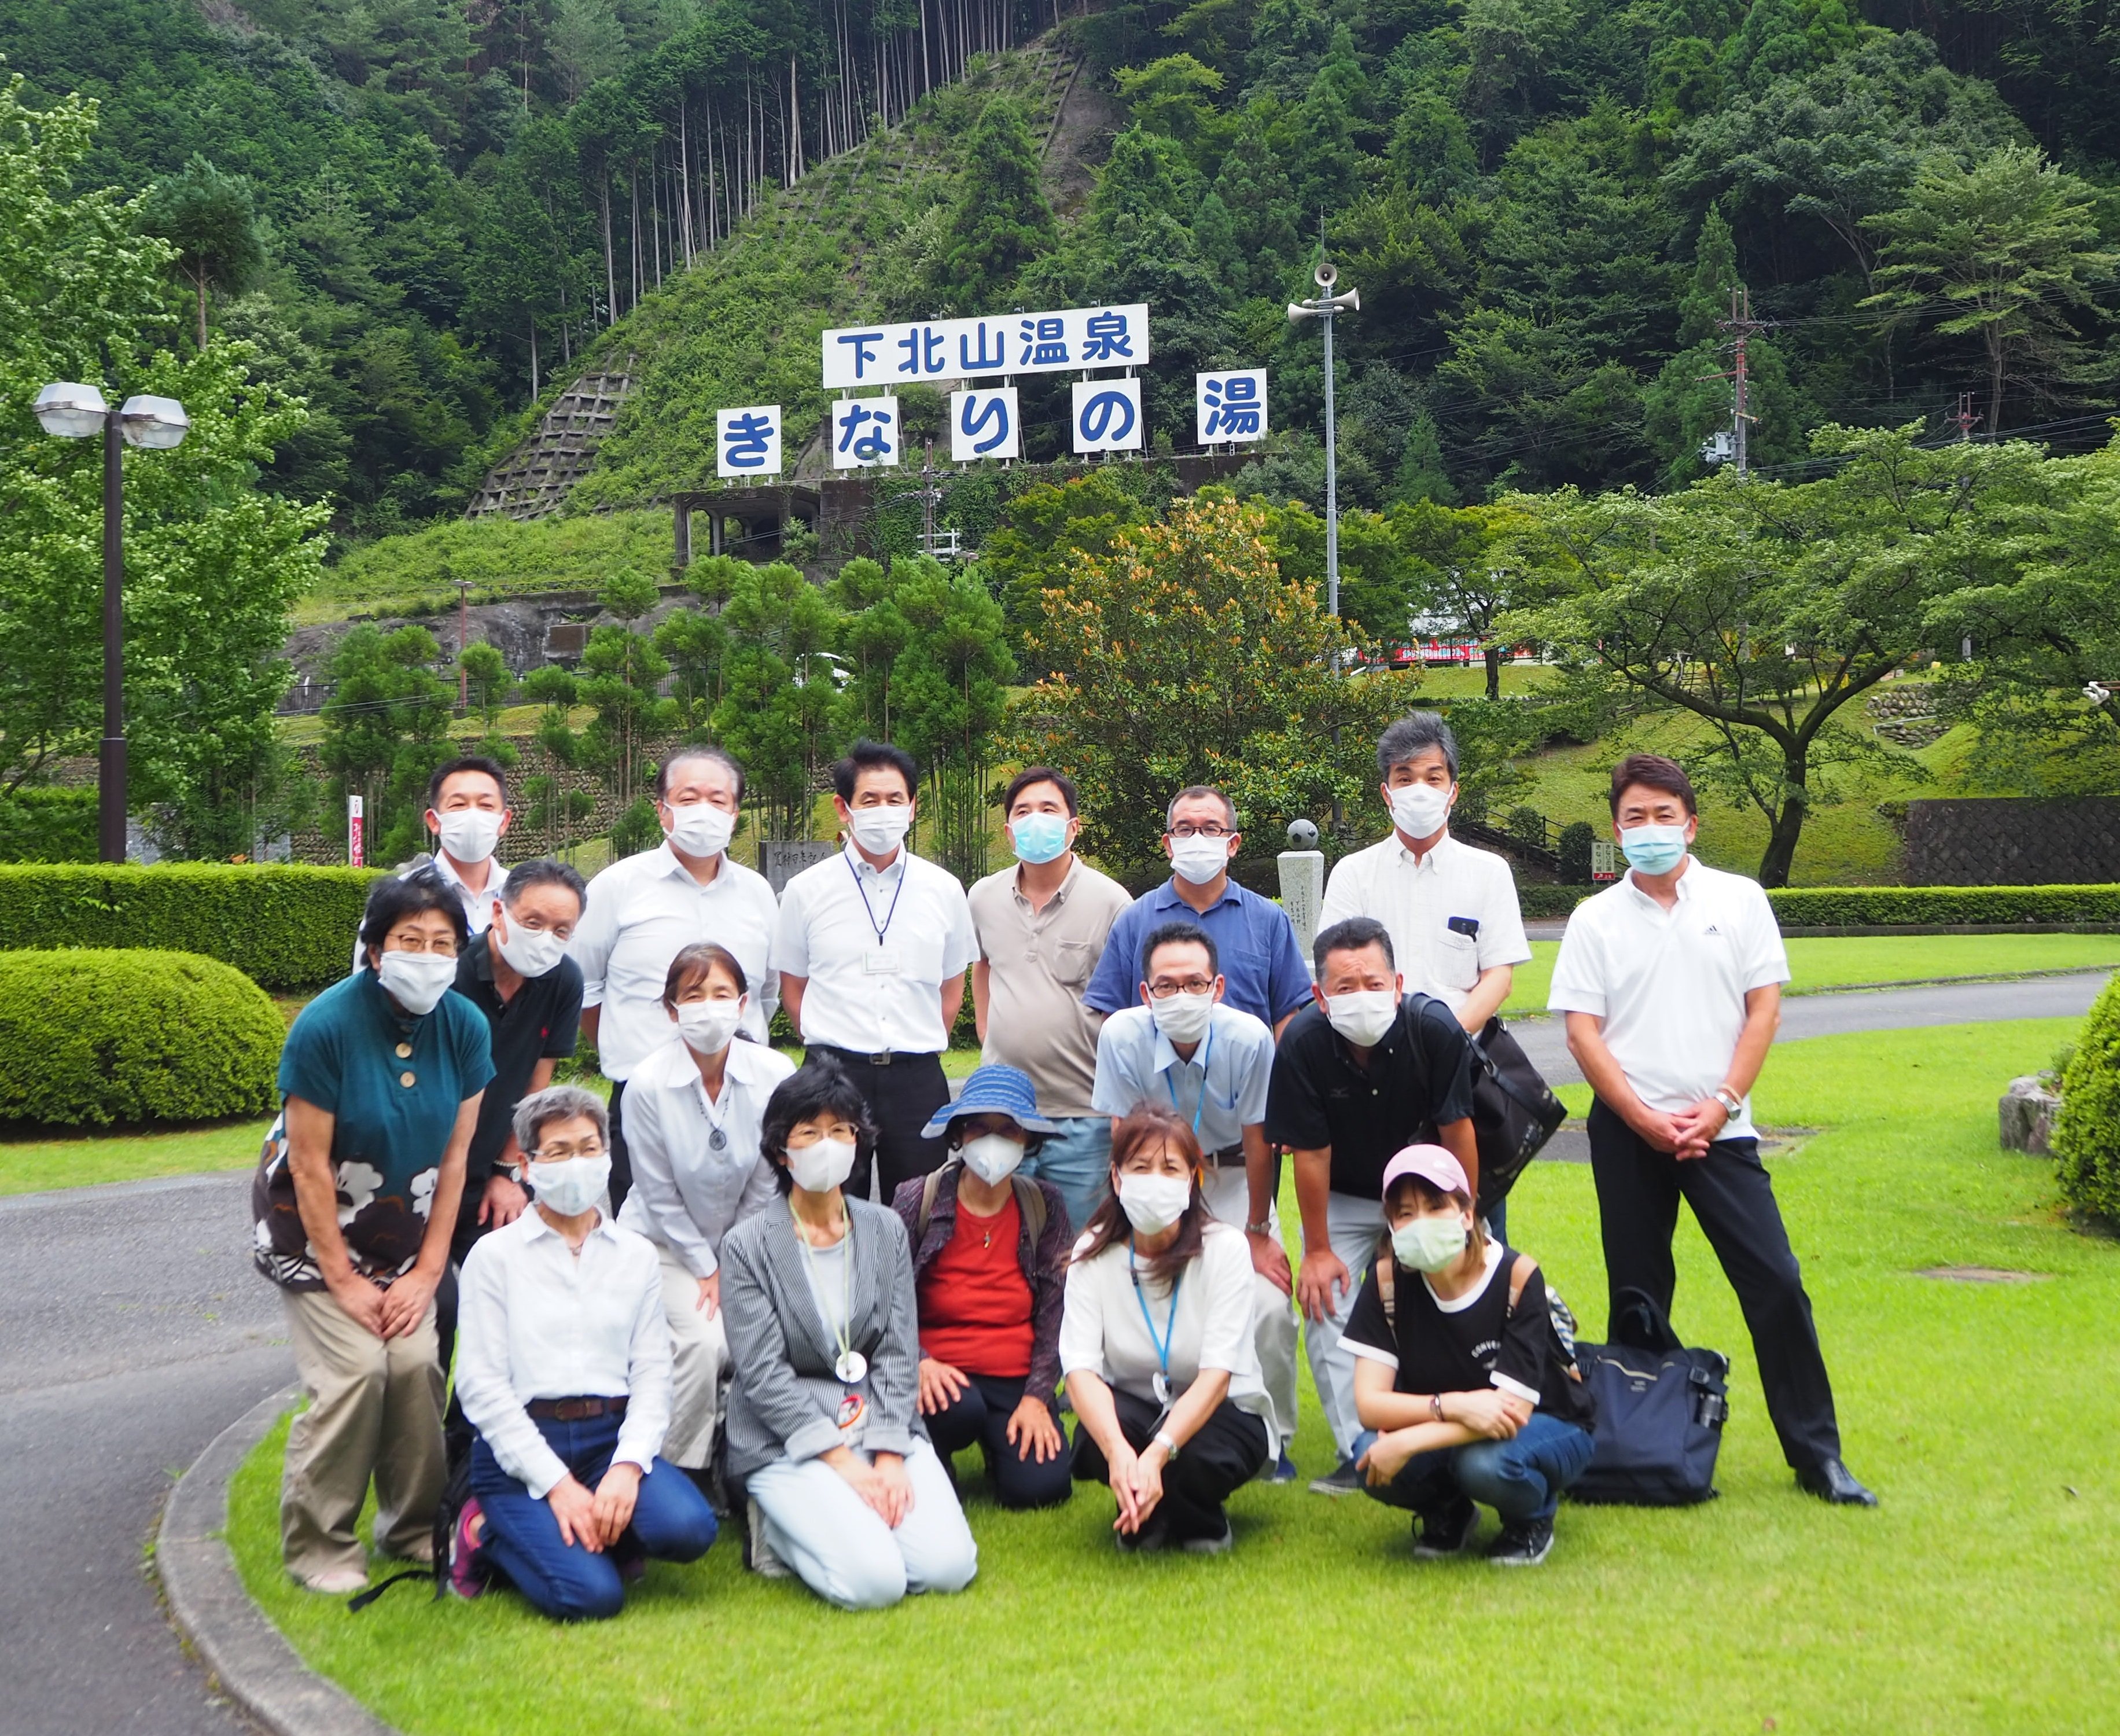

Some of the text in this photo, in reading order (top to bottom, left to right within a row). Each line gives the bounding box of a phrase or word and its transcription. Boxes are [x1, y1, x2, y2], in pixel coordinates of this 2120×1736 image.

[837, 311, 1133, 378] 下北山温泉
[724, 377, 1261, 468] きなりの湯
